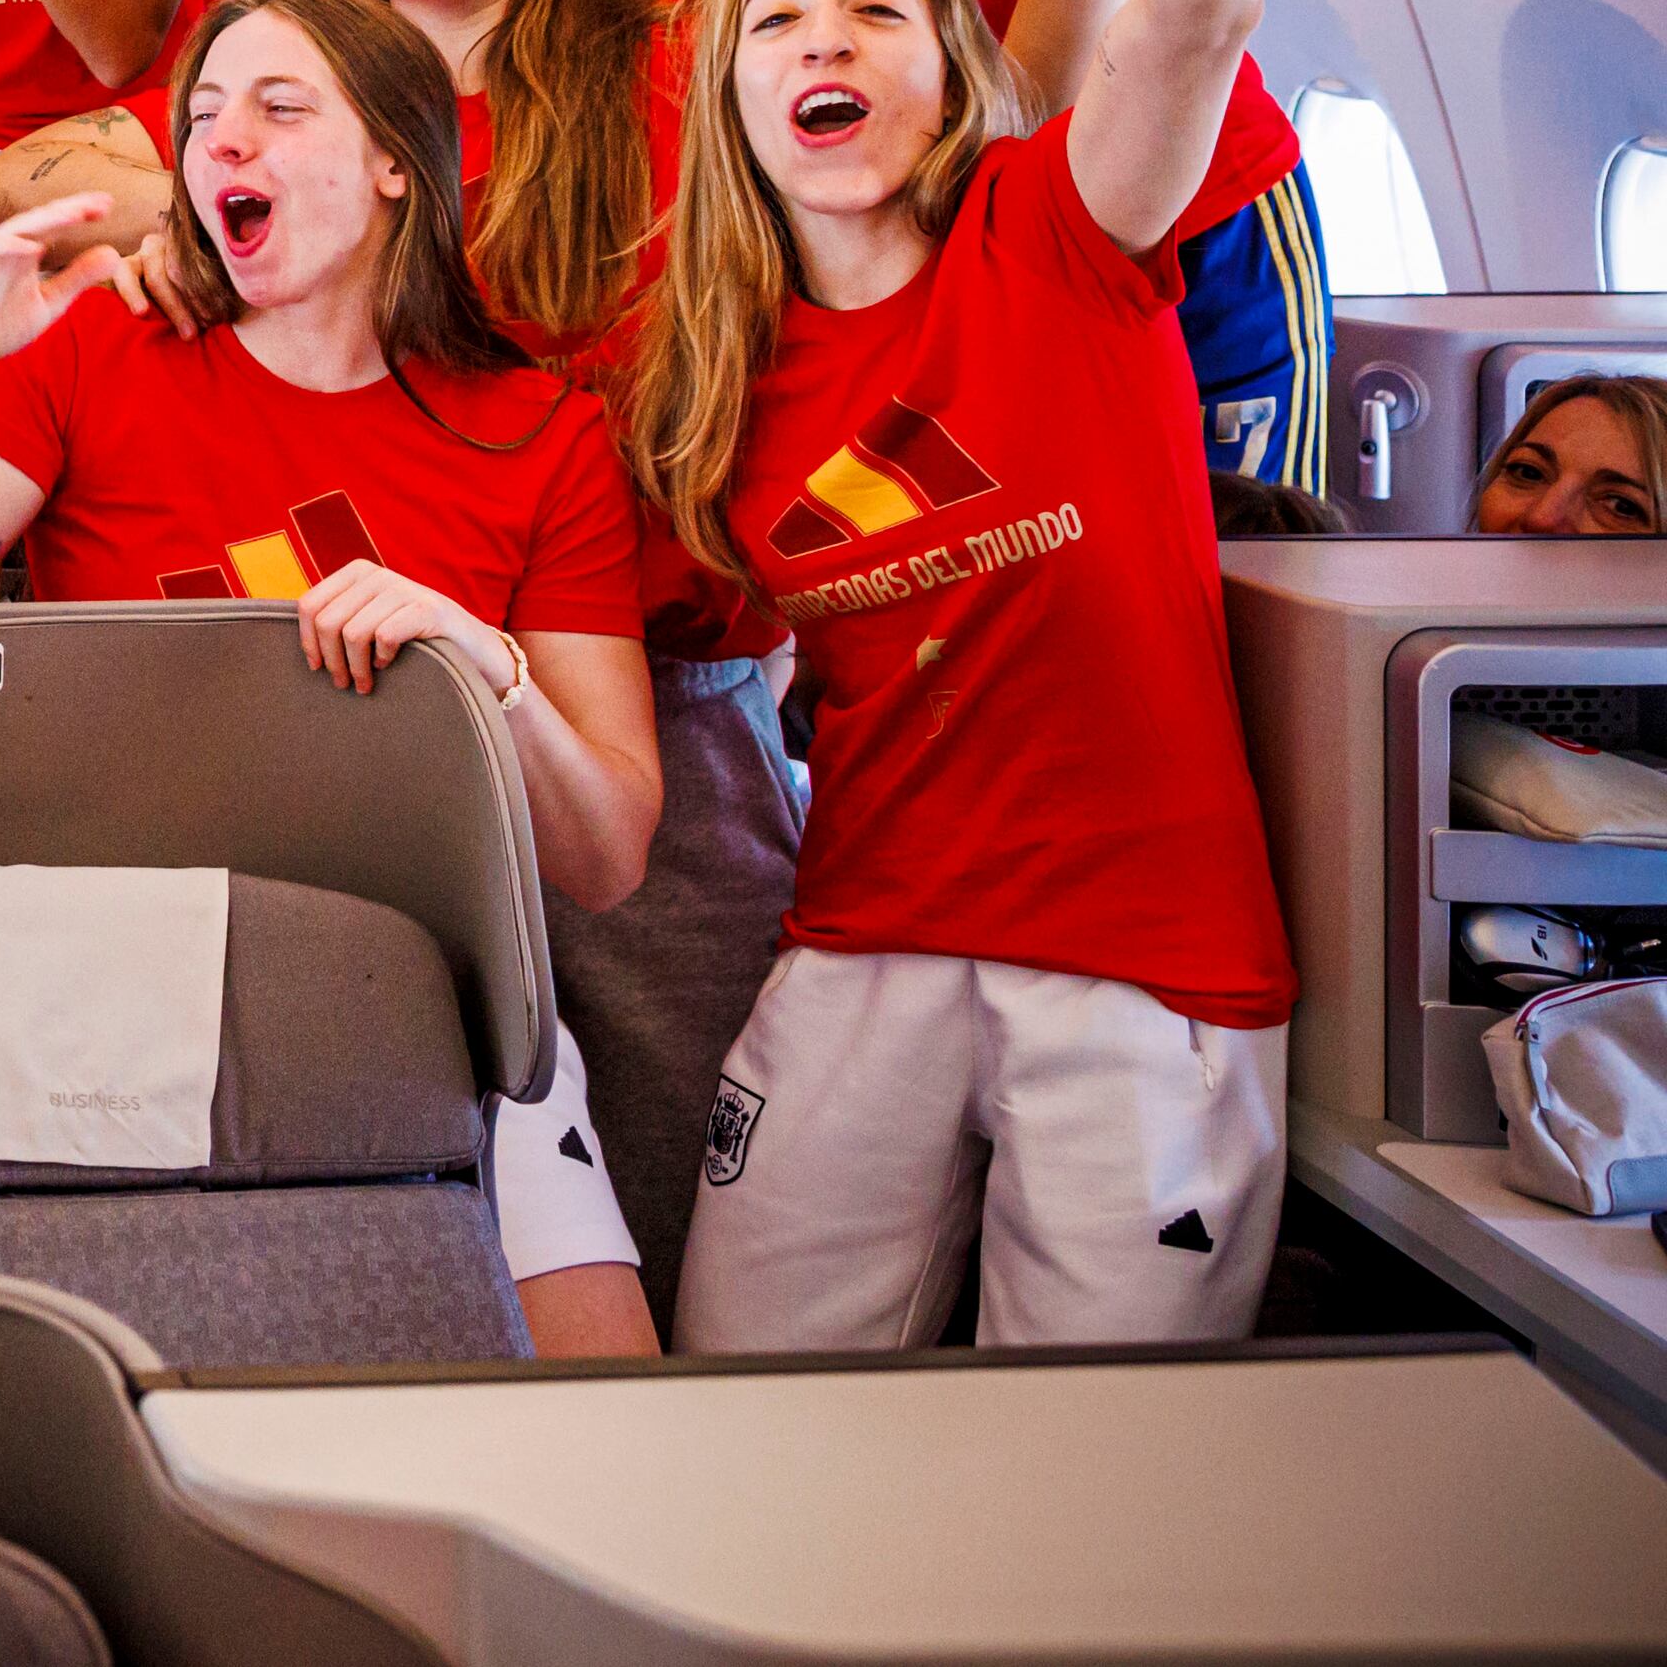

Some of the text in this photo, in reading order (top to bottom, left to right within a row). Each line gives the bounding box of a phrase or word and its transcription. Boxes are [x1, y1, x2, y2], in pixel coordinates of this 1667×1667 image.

[774, 502, 1084, 623] AMPEONAS DEL MUNDO
[49, 1092, 141, 1111] BUSINESS
